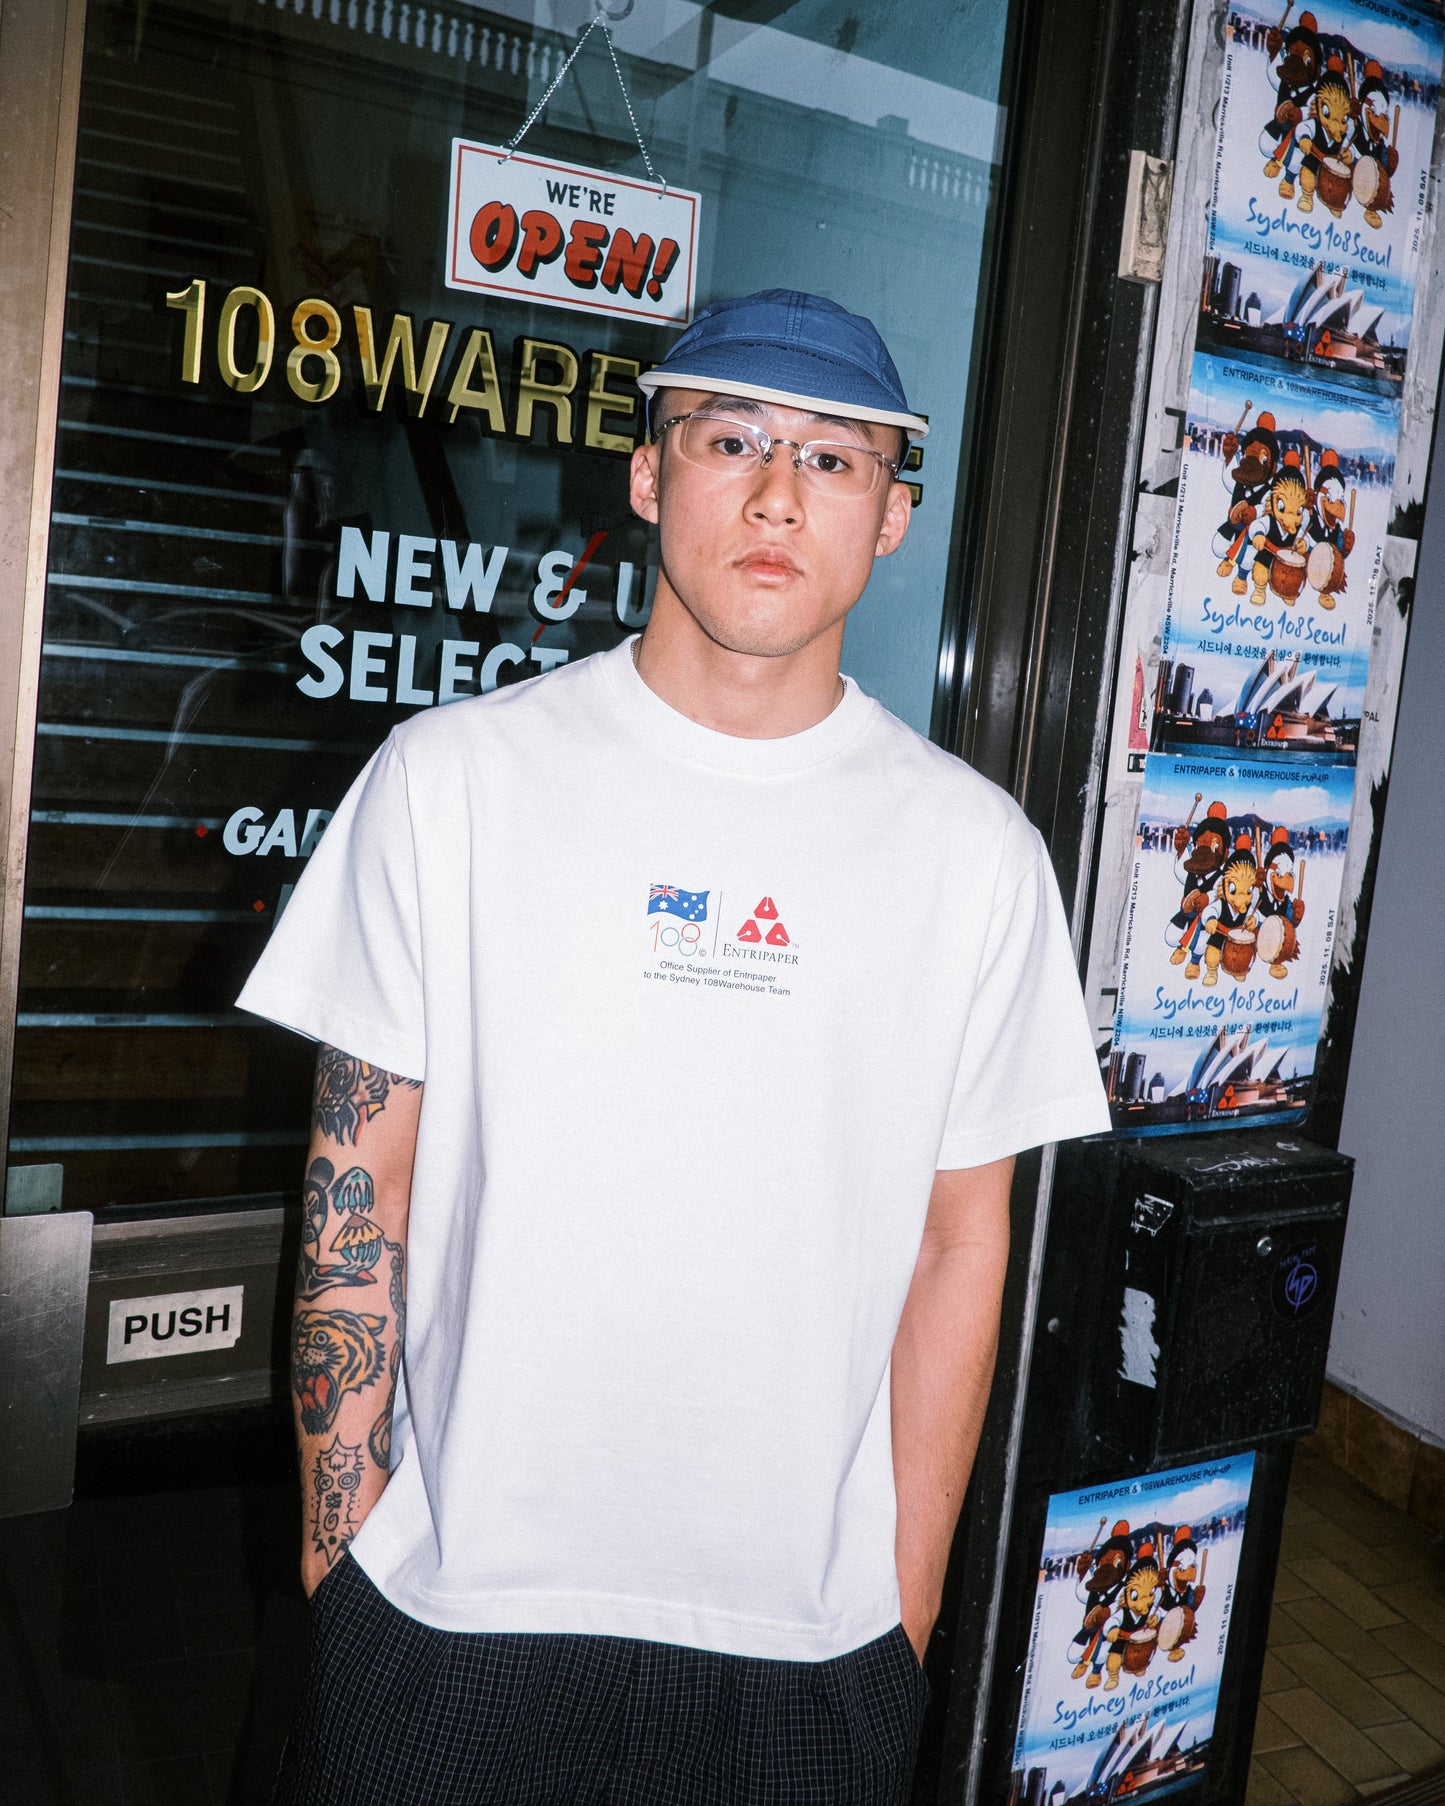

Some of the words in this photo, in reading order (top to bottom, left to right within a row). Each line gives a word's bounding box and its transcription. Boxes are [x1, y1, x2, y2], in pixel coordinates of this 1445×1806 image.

[546, 180, 616, 216] WE'RE
[469, 201, 681, 302] OPEN!
[1243, 240, 1279, 260] 시드니에
[1222, 366, 1276, 389] ENTRIPAPER
[1277, 381, 1284, 389] &
[1173, 505, 1184, 551] Marrickville
[336, 526, 509, 613] NEW
[533, 550, 588, 621] &
[1197, 640, 1232, 655] 시드니에
[1234, 645, 1267, 660] 오신것을
[1303, 654, 1341, 668] 환영합니다.
[1174, 764, 1226, 777] ENTRIPAPER
[1228, 768, 1235, 777] &
[1238, 768, 1300, 782] 108WAREHOUSE
[222, 806, 336, 858] GAR
[1125, 902, 1136, 946] Marrickville
[1327, 909, 1335, 928] SAT
[723, 943, 800, 966] ENTRIPAPER
[643, 971, 651, 979] to
[654, 972, 667, 981] the
[669, 974, 701, 986] Sydney
[703, 978, 766, 993] 108Warehouse
[768, 986, 791, 996] Team
[660, 960, 684, 972] Office
[686, 964, 721, 976] Supplier
[723, 969, 731, 977] of
[733, 970, 777, 984] Entripaper
[1150, 1026, 1183, 1039] 시드니에
[1186, 1024, 1218, 1037] 오신것을
[1255, 1020, 1293, 1033] 환영합니다.
[123, 1303, 231, 1346] PUSH
[1078, 1486, 1130, 1505] ENTRIPAPER
